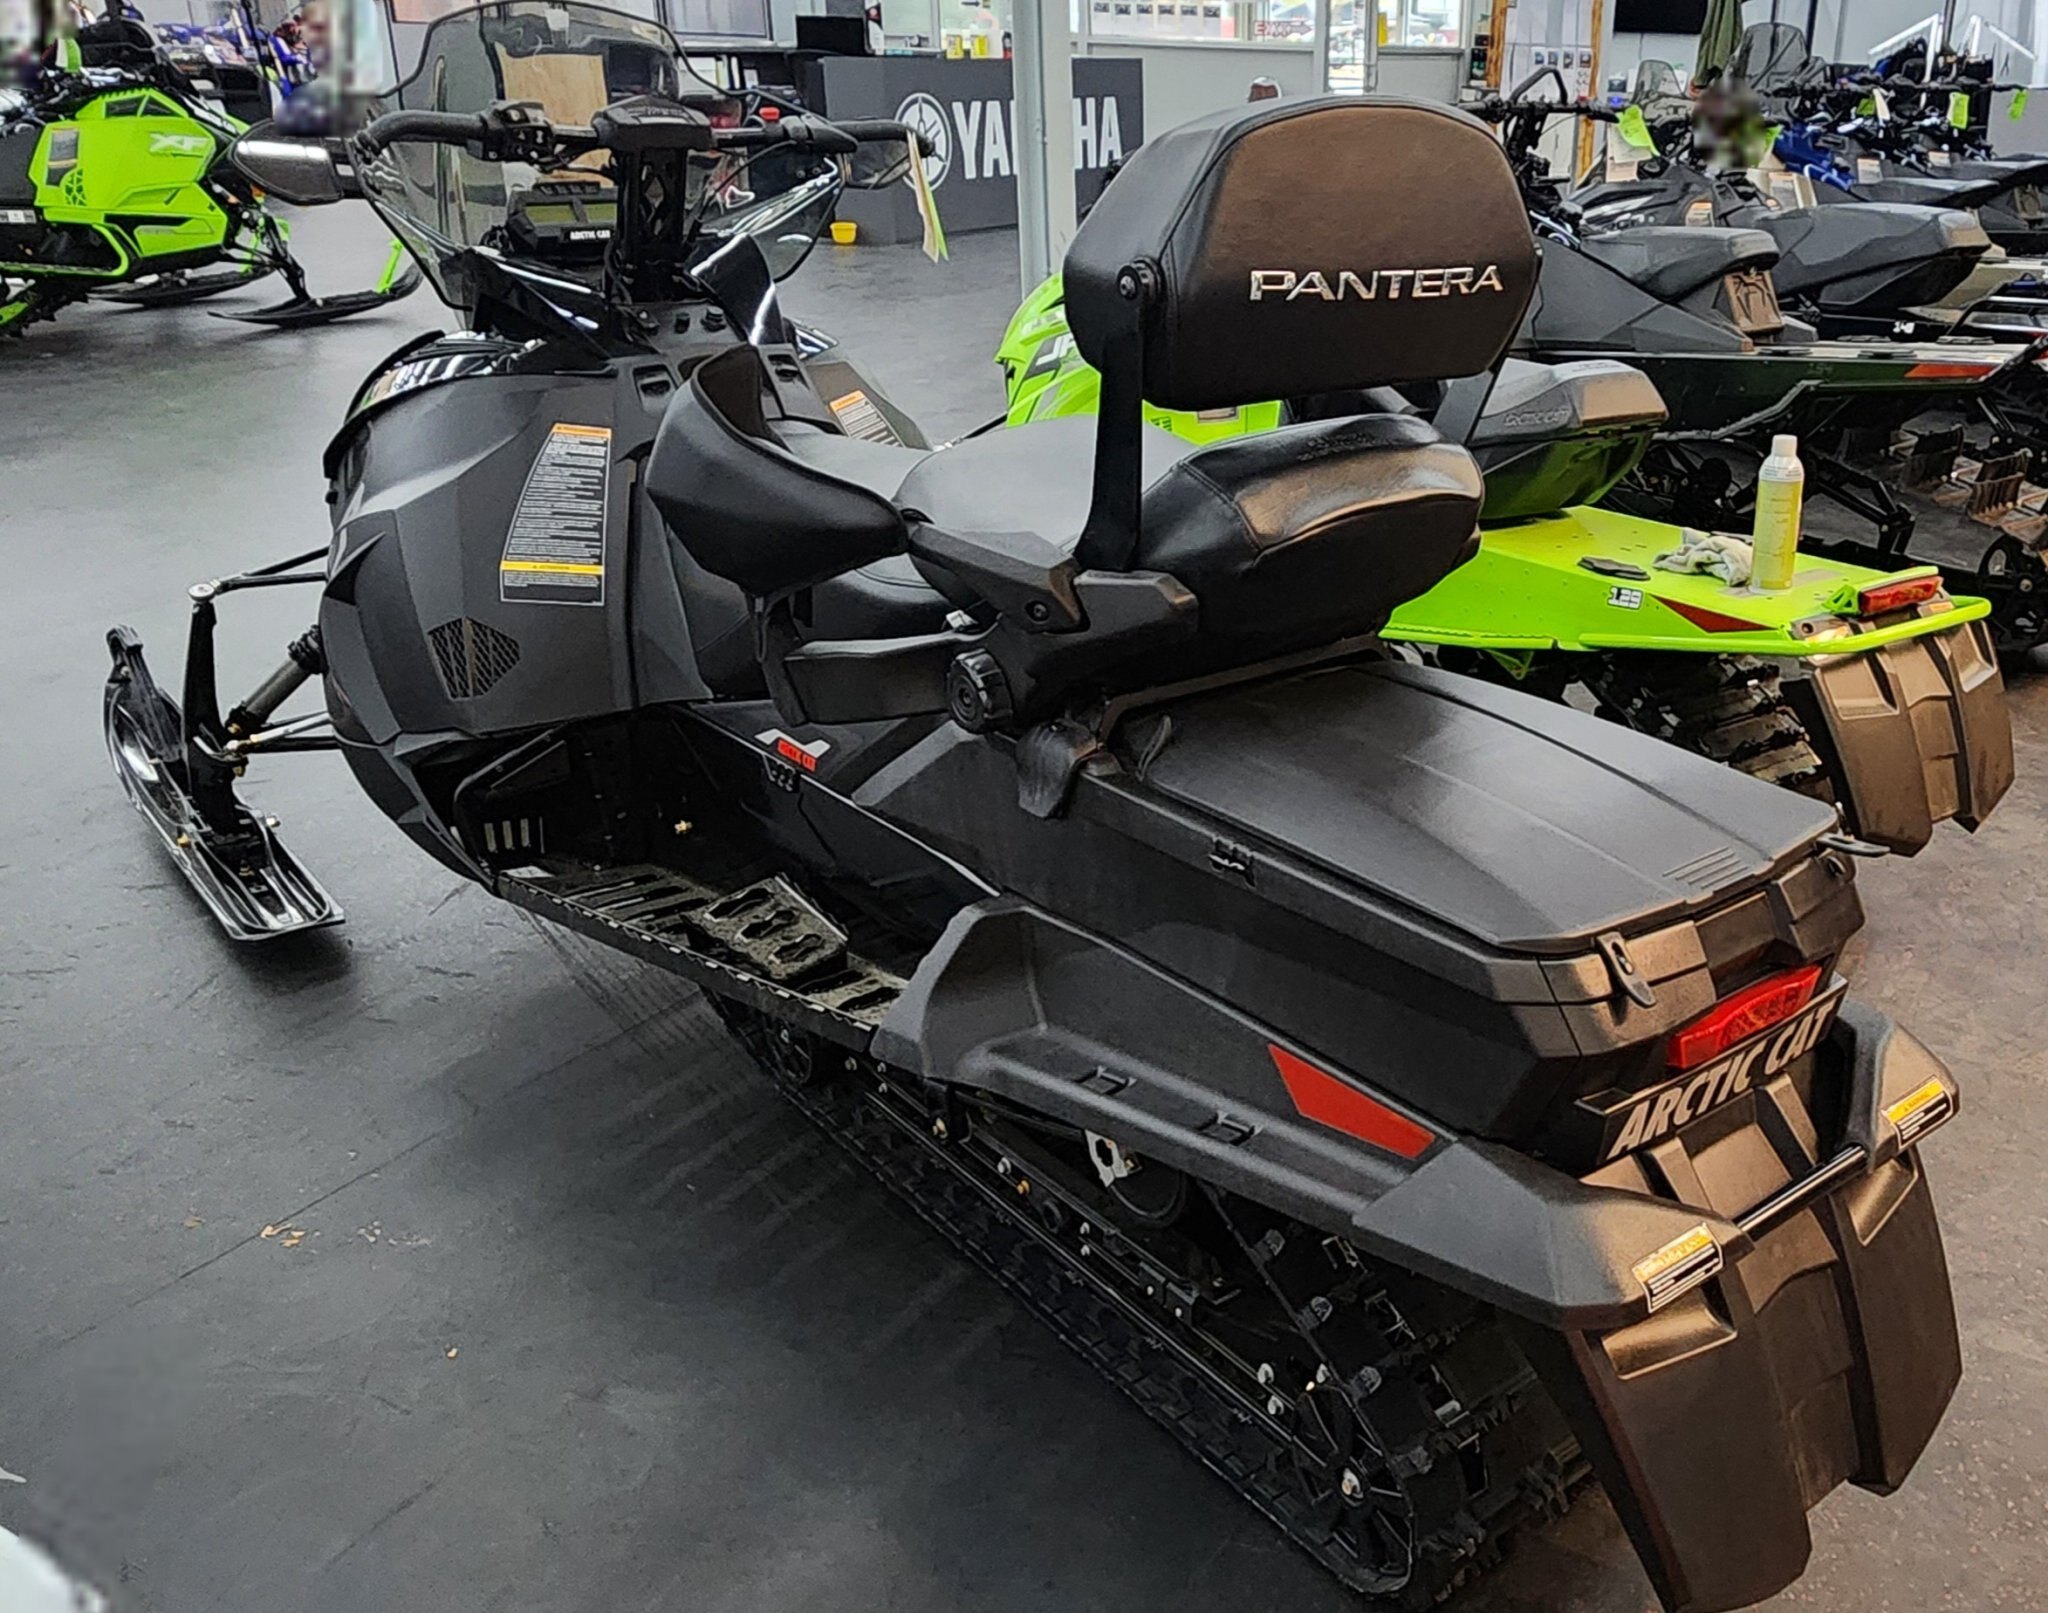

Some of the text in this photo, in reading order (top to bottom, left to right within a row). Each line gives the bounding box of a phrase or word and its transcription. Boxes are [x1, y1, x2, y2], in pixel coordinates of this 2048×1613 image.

[149, 132, 209, 153] XF
[951, 96, 1123, 180] YAHA
[1249, 265, 1504, 301] PANTERA
[1605, 996, 1838, 1160] ARCTIC CAT
